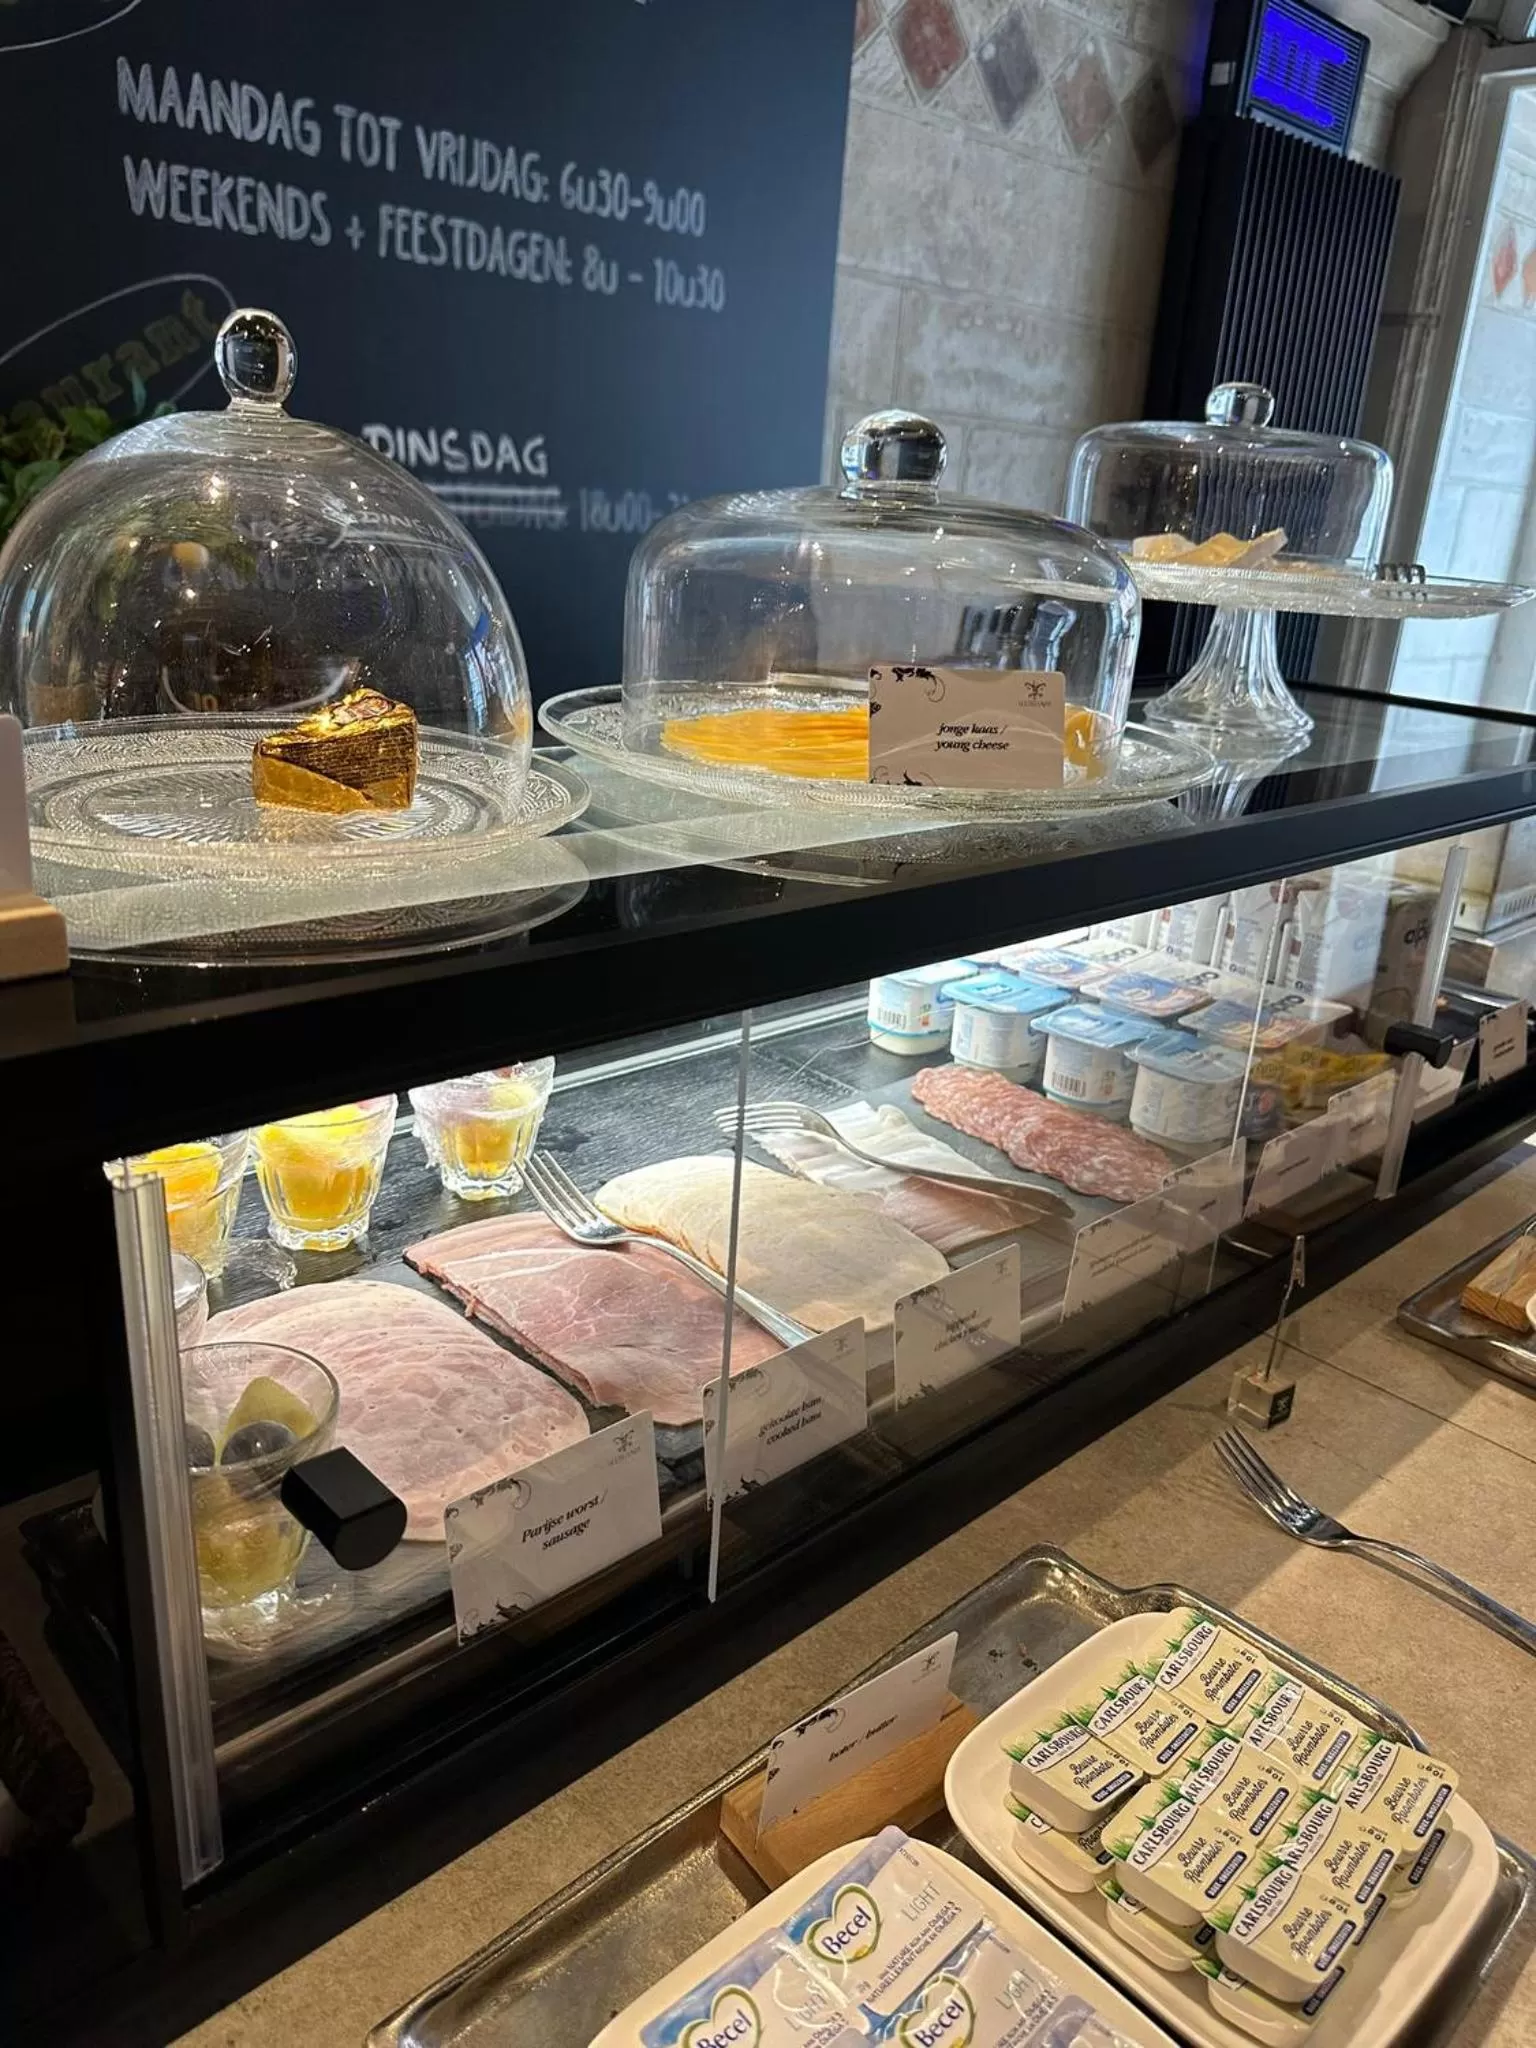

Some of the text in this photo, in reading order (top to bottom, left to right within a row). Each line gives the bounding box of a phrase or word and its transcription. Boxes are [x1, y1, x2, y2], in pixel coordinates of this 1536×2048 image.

[117, 55, 322, 157] MAANDAG
[333, 103, 402, 172] TOT
[415, 124, 550, 203] VRIJDAG:
[123, 154, 332, 247] WEEKENDS
[362, 423, 549, 477] DINSDAG
[934, 739, 1010, 752] young cheese
[936, 722, 969, 736] jonge
[972, 723, 998, 734] kaas
[542, 1518, 591, 1551] sausage
[566, 1495, 600, 1520] worst
[1160, 1625, 1213, 1685] CARLSBOURG
[1249, 1687, 1297, 1747] ARLSBOUR
[1026, 1726, 1087, 1768] CARLSBOURG
[1184, 1741, 1235, 1801] ARLSBOURG
[1344, 1744, 1392, 1810] ARLSBOURG
[1132, 1802, 1190, 1865] CARLSBOURG
[1286, 1804, 1333, 1872] ARLSBOURG
[901, 1880, 941, 1922] LIGHT
[1235, 1870, 1293, 1936] CARLSBOURG
[821, 1905, 872, 1955] Becel
[696, 2008, 752, 2048] Becel
[914, 1999, 964, 2048] Becel
